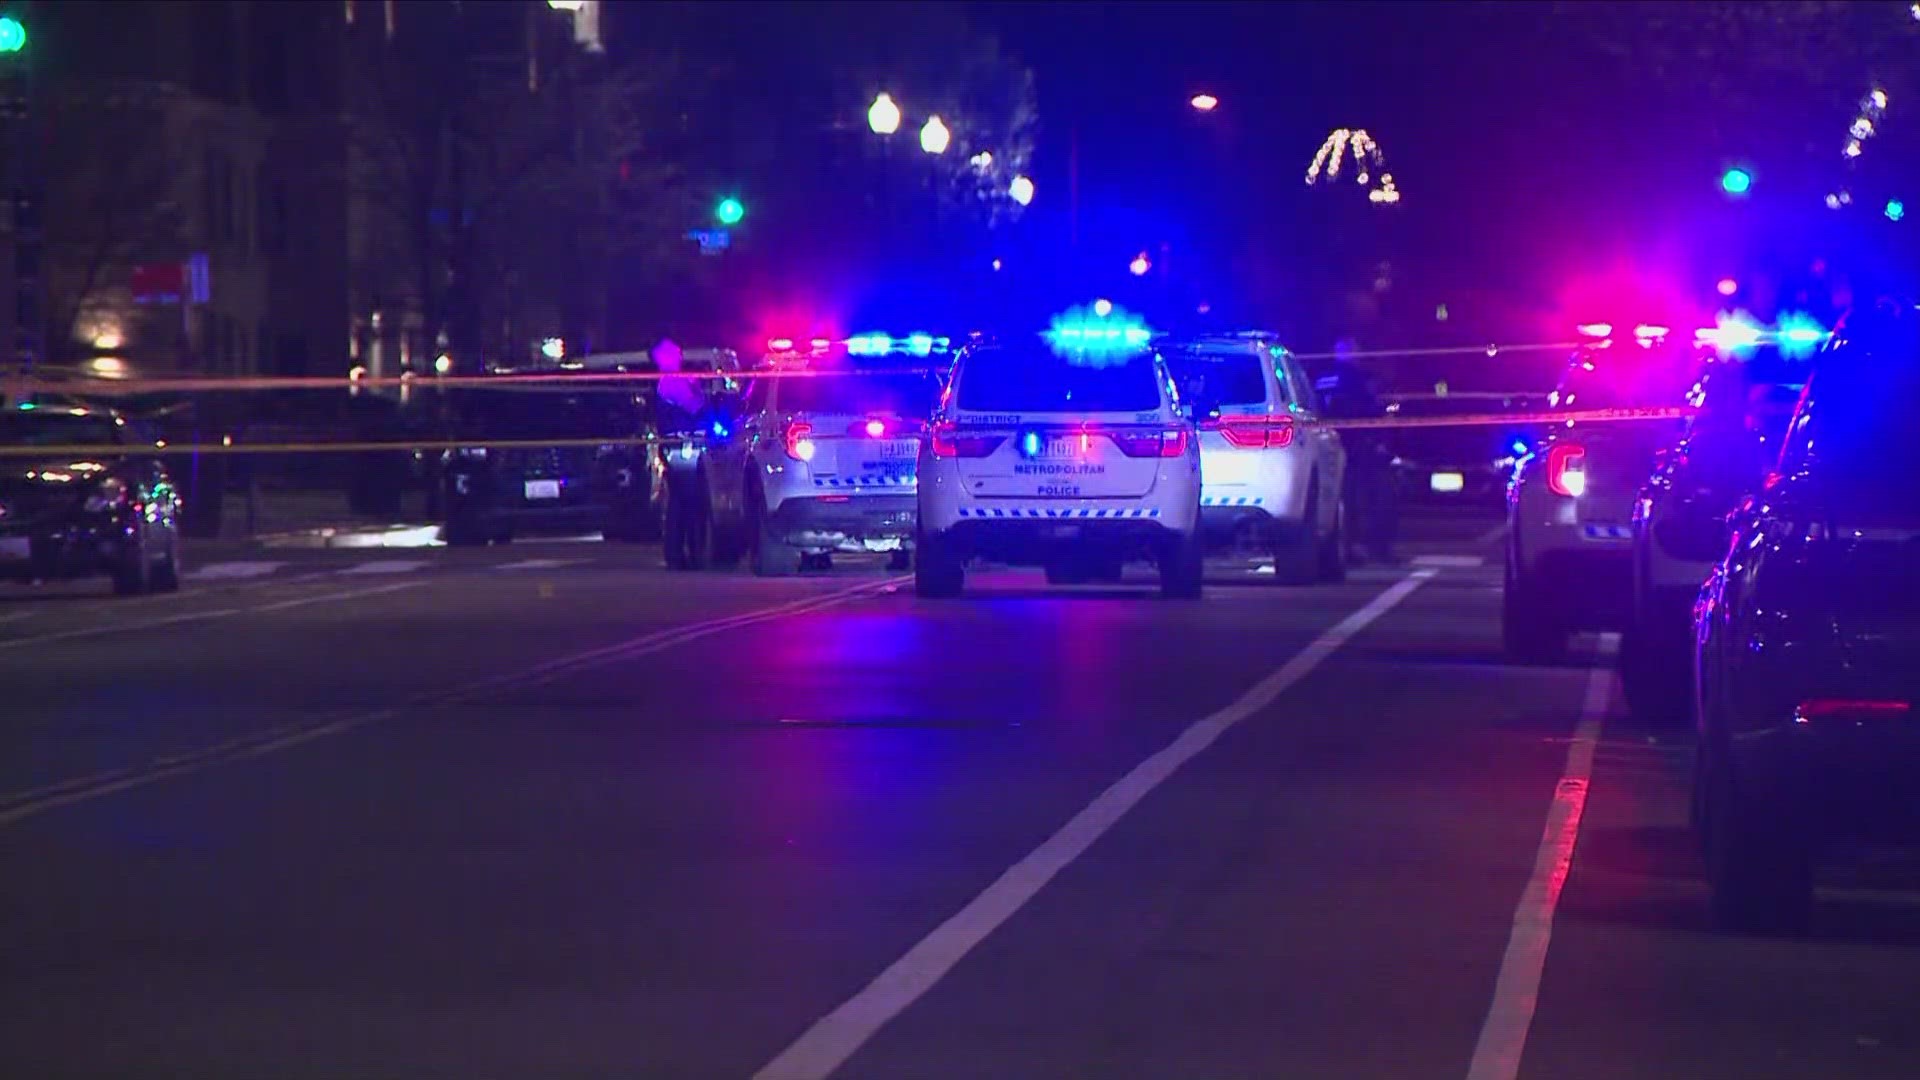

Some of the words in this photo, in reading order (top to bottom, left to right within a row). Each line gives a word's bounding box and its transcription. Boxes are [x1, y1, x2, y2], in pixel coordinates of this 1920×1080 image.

[972, 414, 1021, 424] DISTRICT
[1014, 465, 1105, 475] METROPOLITAN
[1038, 486, 1080, 496] POLICE
